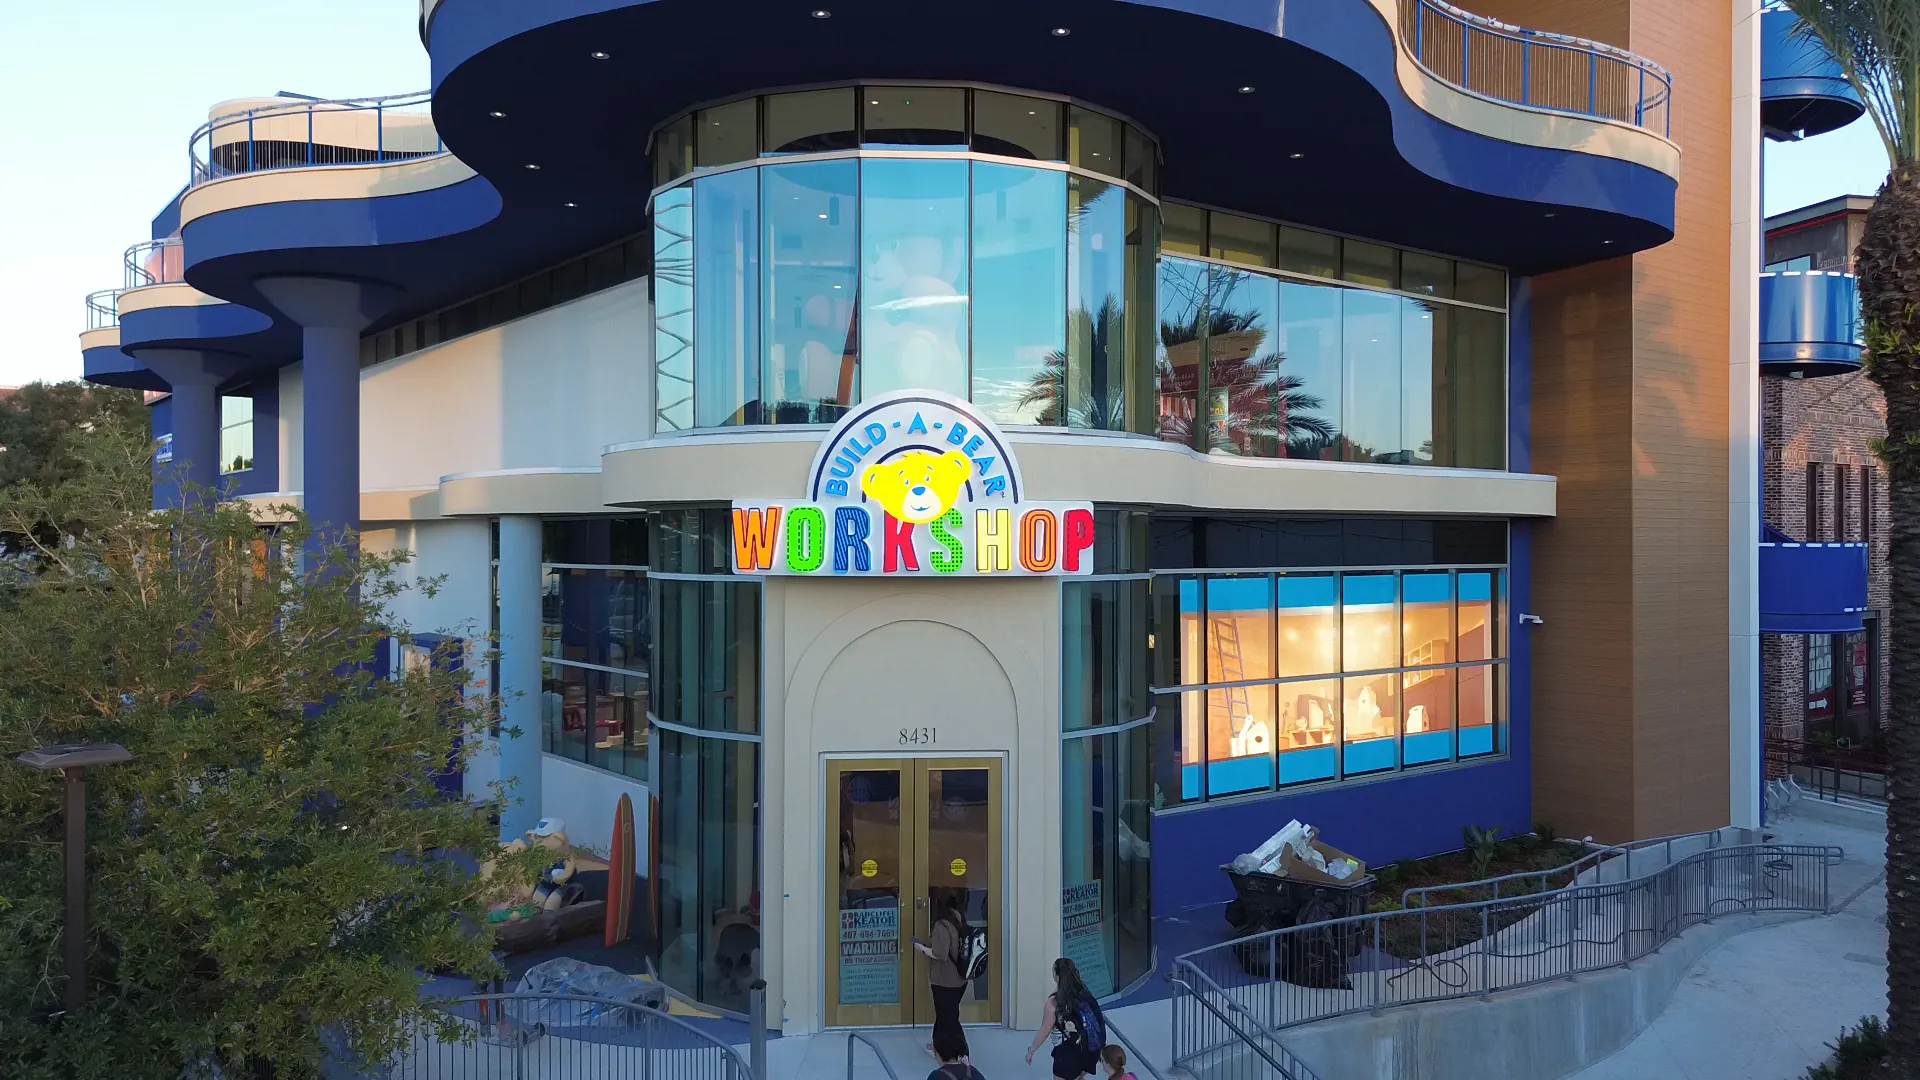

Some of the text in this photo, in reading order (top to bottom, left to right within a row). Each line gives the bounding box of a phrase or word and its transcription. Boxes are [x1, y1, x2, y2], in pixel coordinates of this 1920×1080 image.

[825, 412, 1006, 497] BUILD-A-BEAR
[732, 506, 1095, 574] WORKSHOP
[899, 727, 936, 745] 8431
[854, 916, 896, 926] KEATOR
[1063, 911, 1100, 931] WARNING
[843, 941, 896, 955] WARNING
